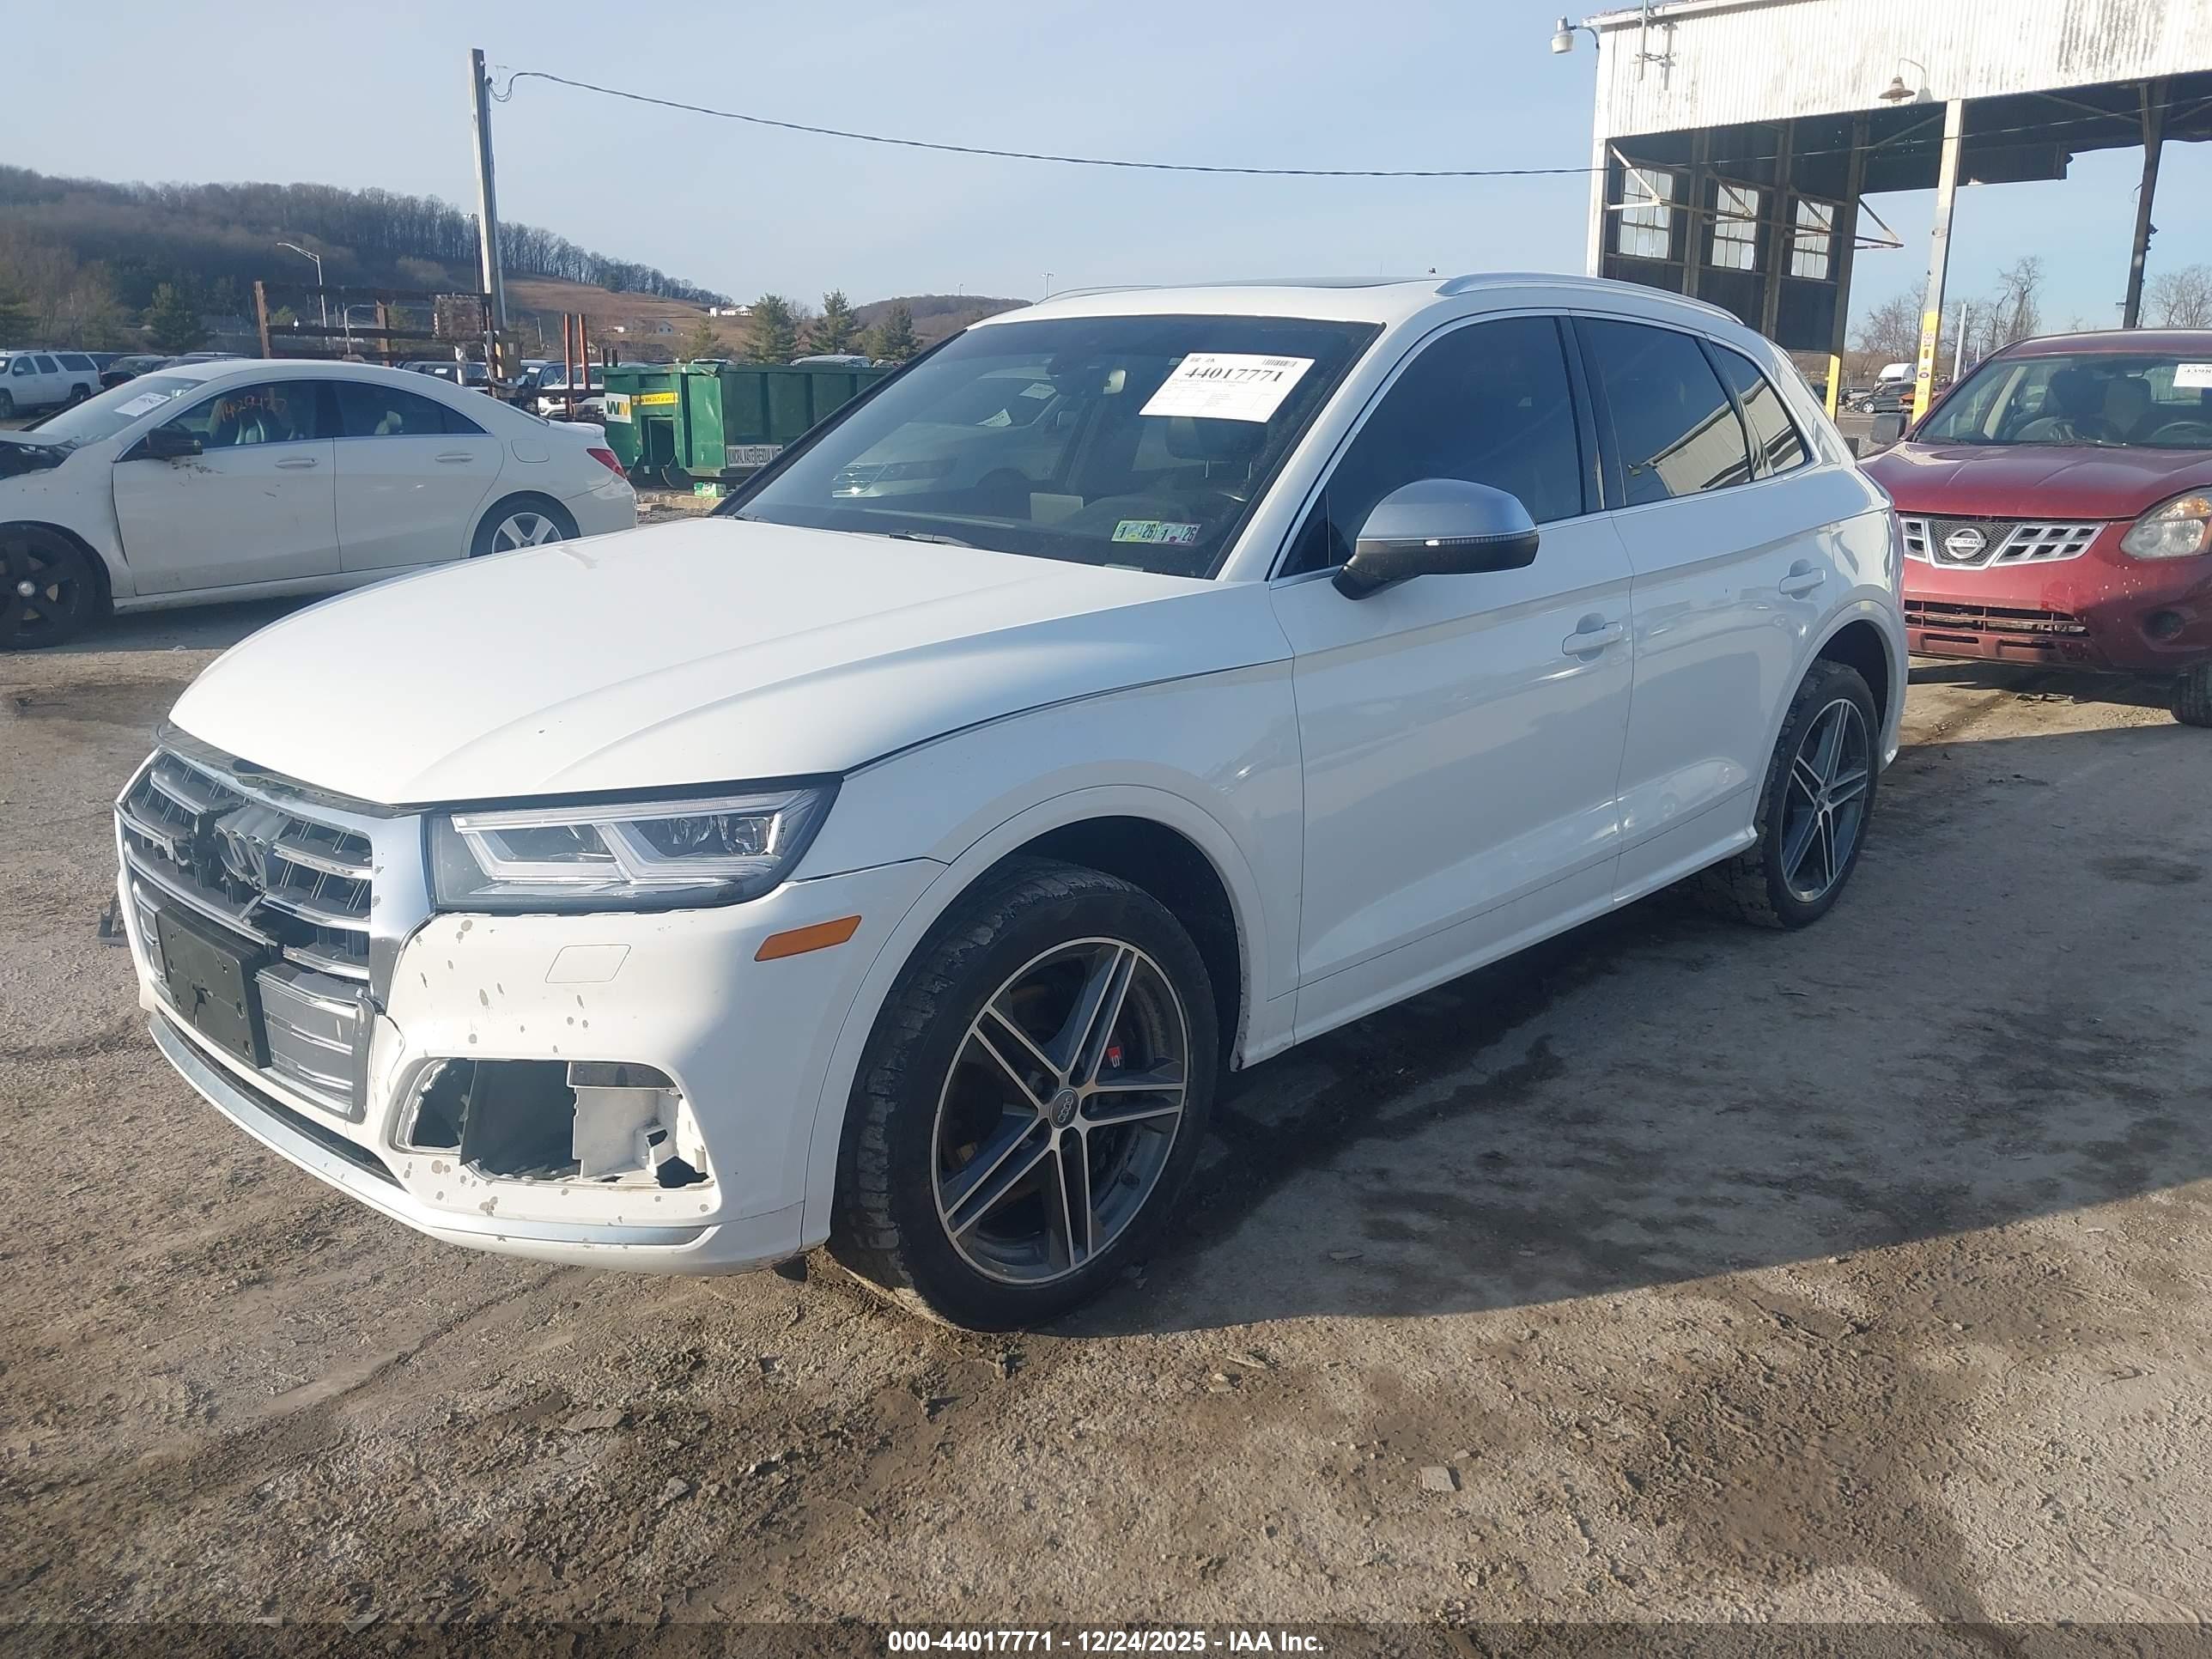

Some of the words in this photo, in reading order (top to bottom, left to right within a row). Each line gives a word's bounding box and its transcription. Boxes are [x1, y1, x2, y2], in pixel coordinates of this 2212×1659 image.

[1184, 367, 1285, 382] 44017771
[606, 400, 629, 416] WM
[1141, 524, 1157, 538] 26
[1182, 526, 1197, 542] 26
